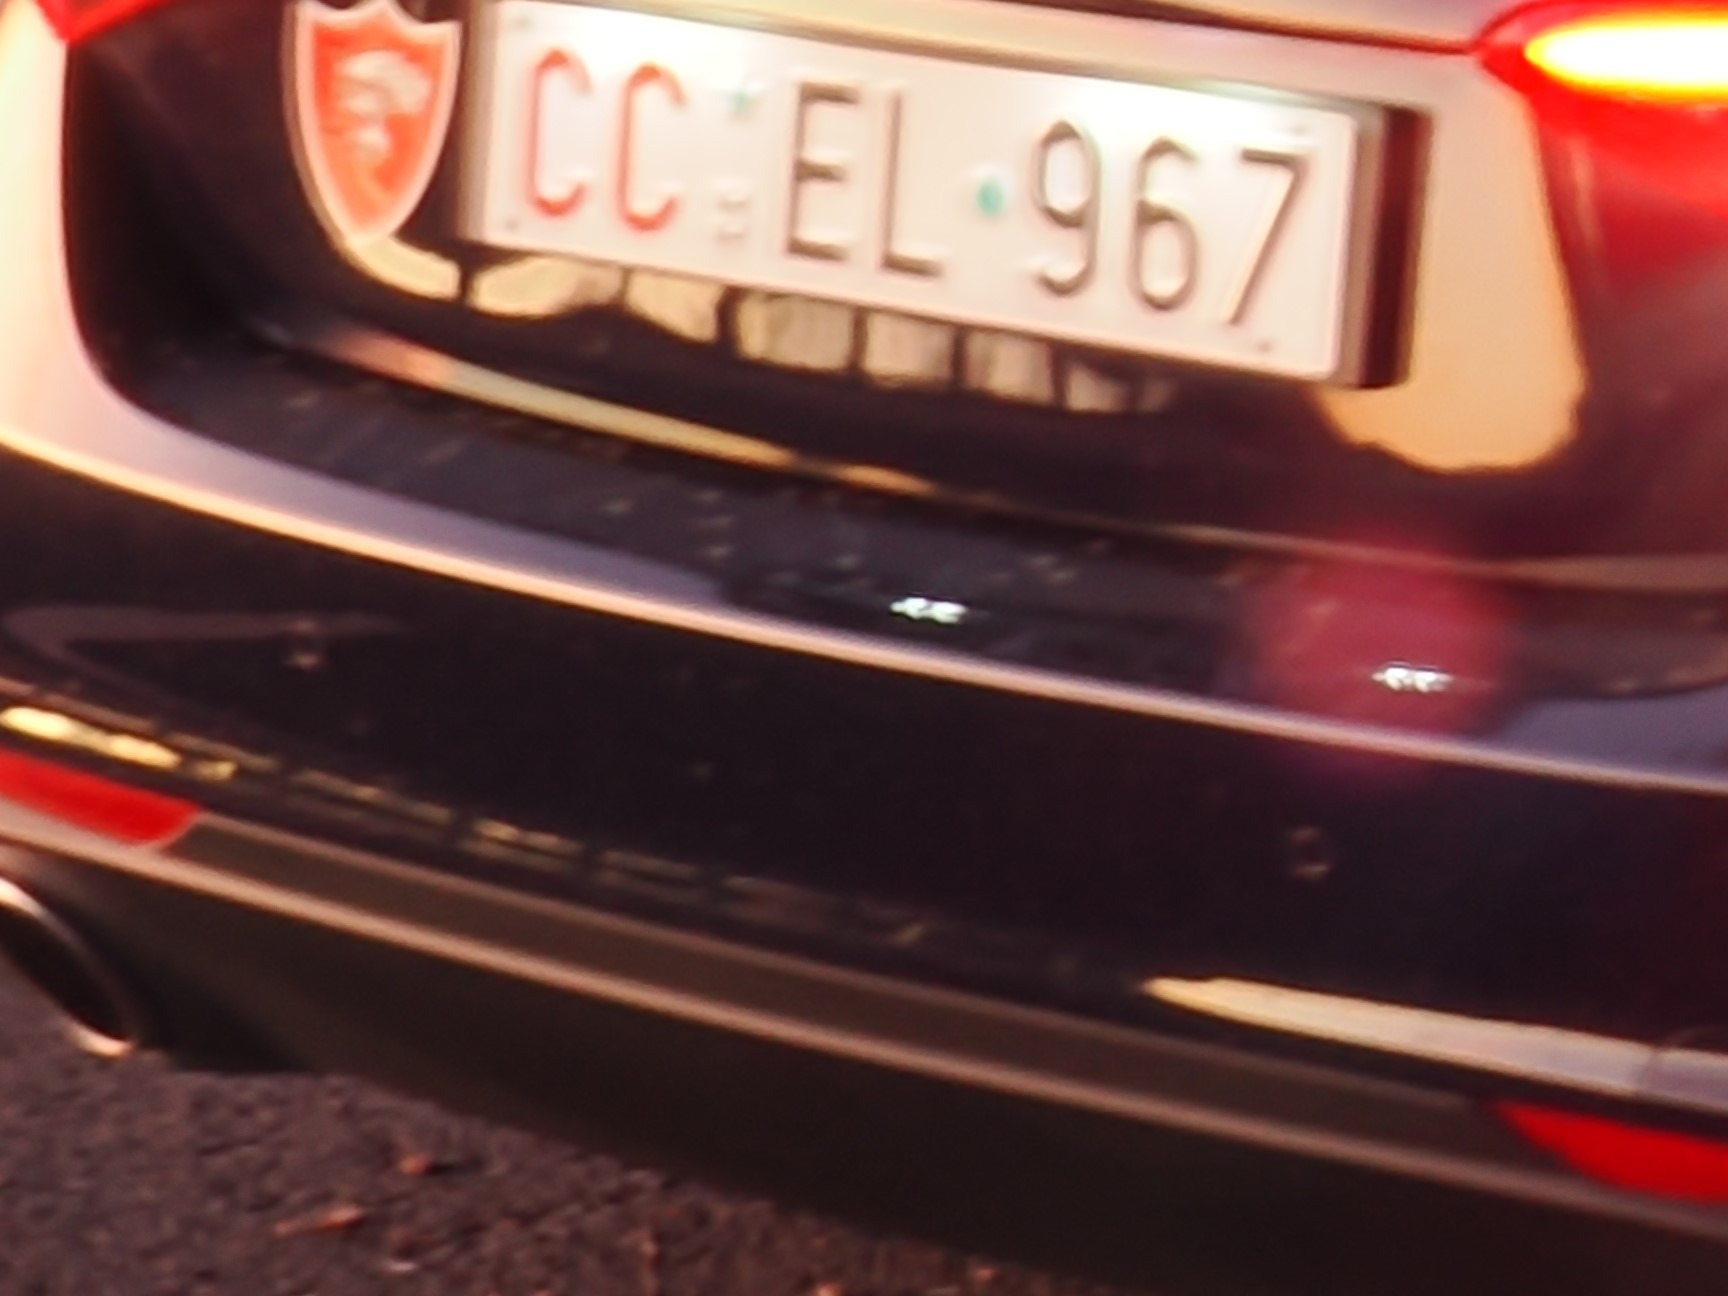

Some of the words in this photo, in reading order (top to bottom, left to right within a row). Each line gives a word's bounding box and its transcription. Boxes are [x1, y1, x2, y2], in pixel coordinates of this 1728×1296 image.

[520, 48, 687, 233] CC
[783, 81, 946, 279] EL
[1028, 116, 1314, 327] 967
